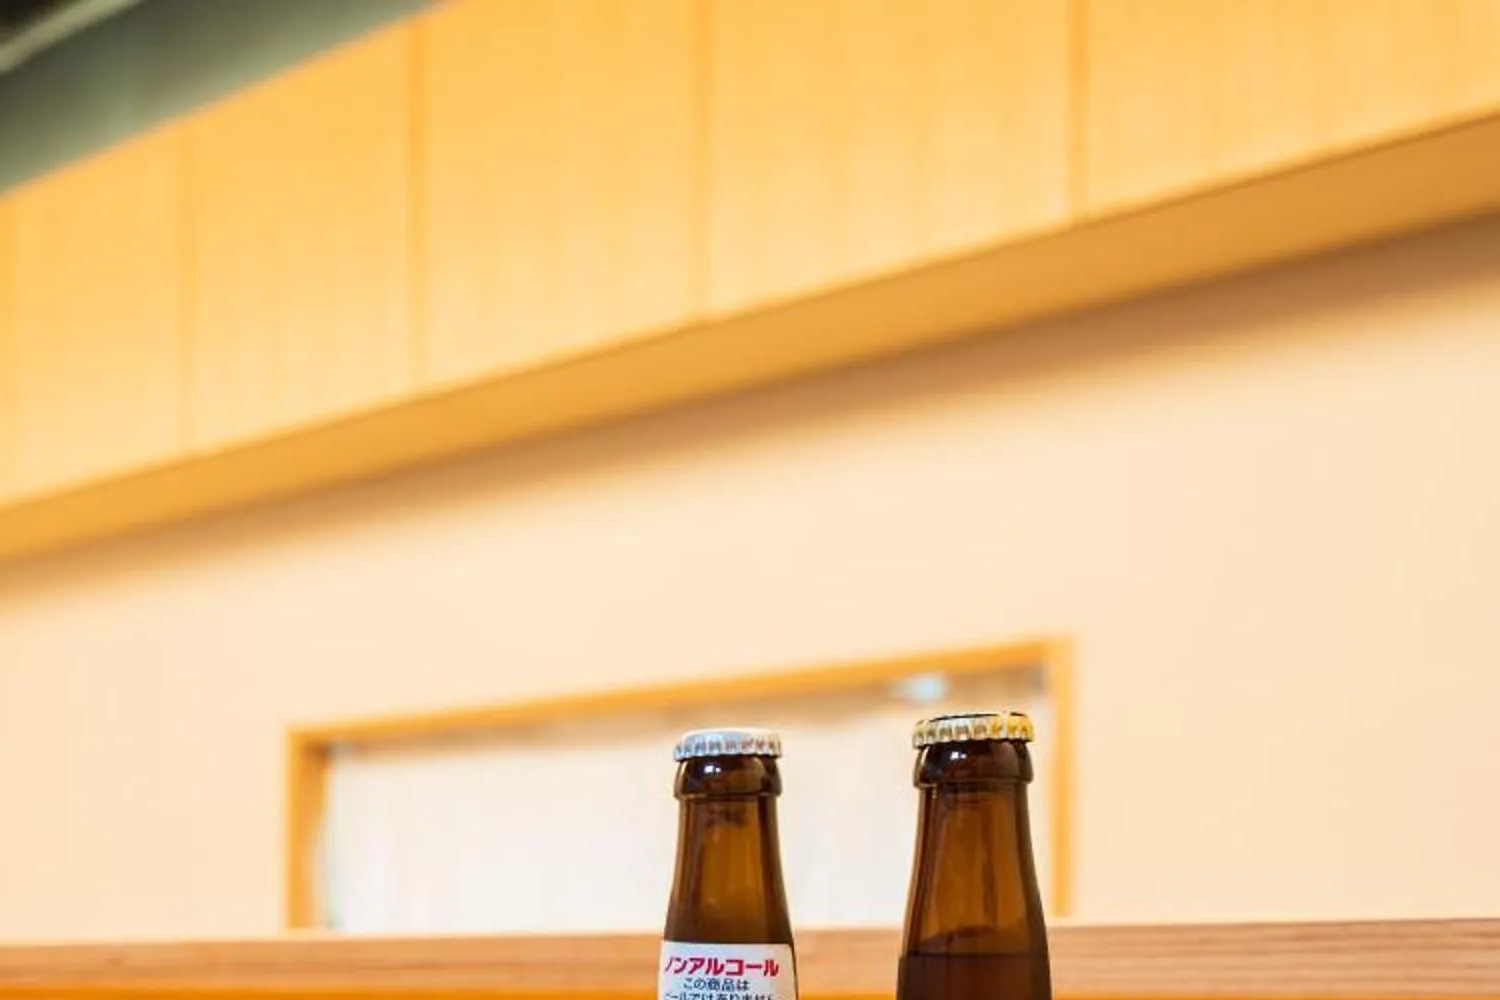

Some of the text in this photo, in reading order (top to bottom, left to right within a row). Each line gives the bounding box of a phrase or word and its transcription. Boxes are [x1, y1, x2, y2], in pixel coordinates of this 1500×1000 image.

[665, 957, 779, 976] ノンアルコール
[683, 978, 750, 991] この商品は
